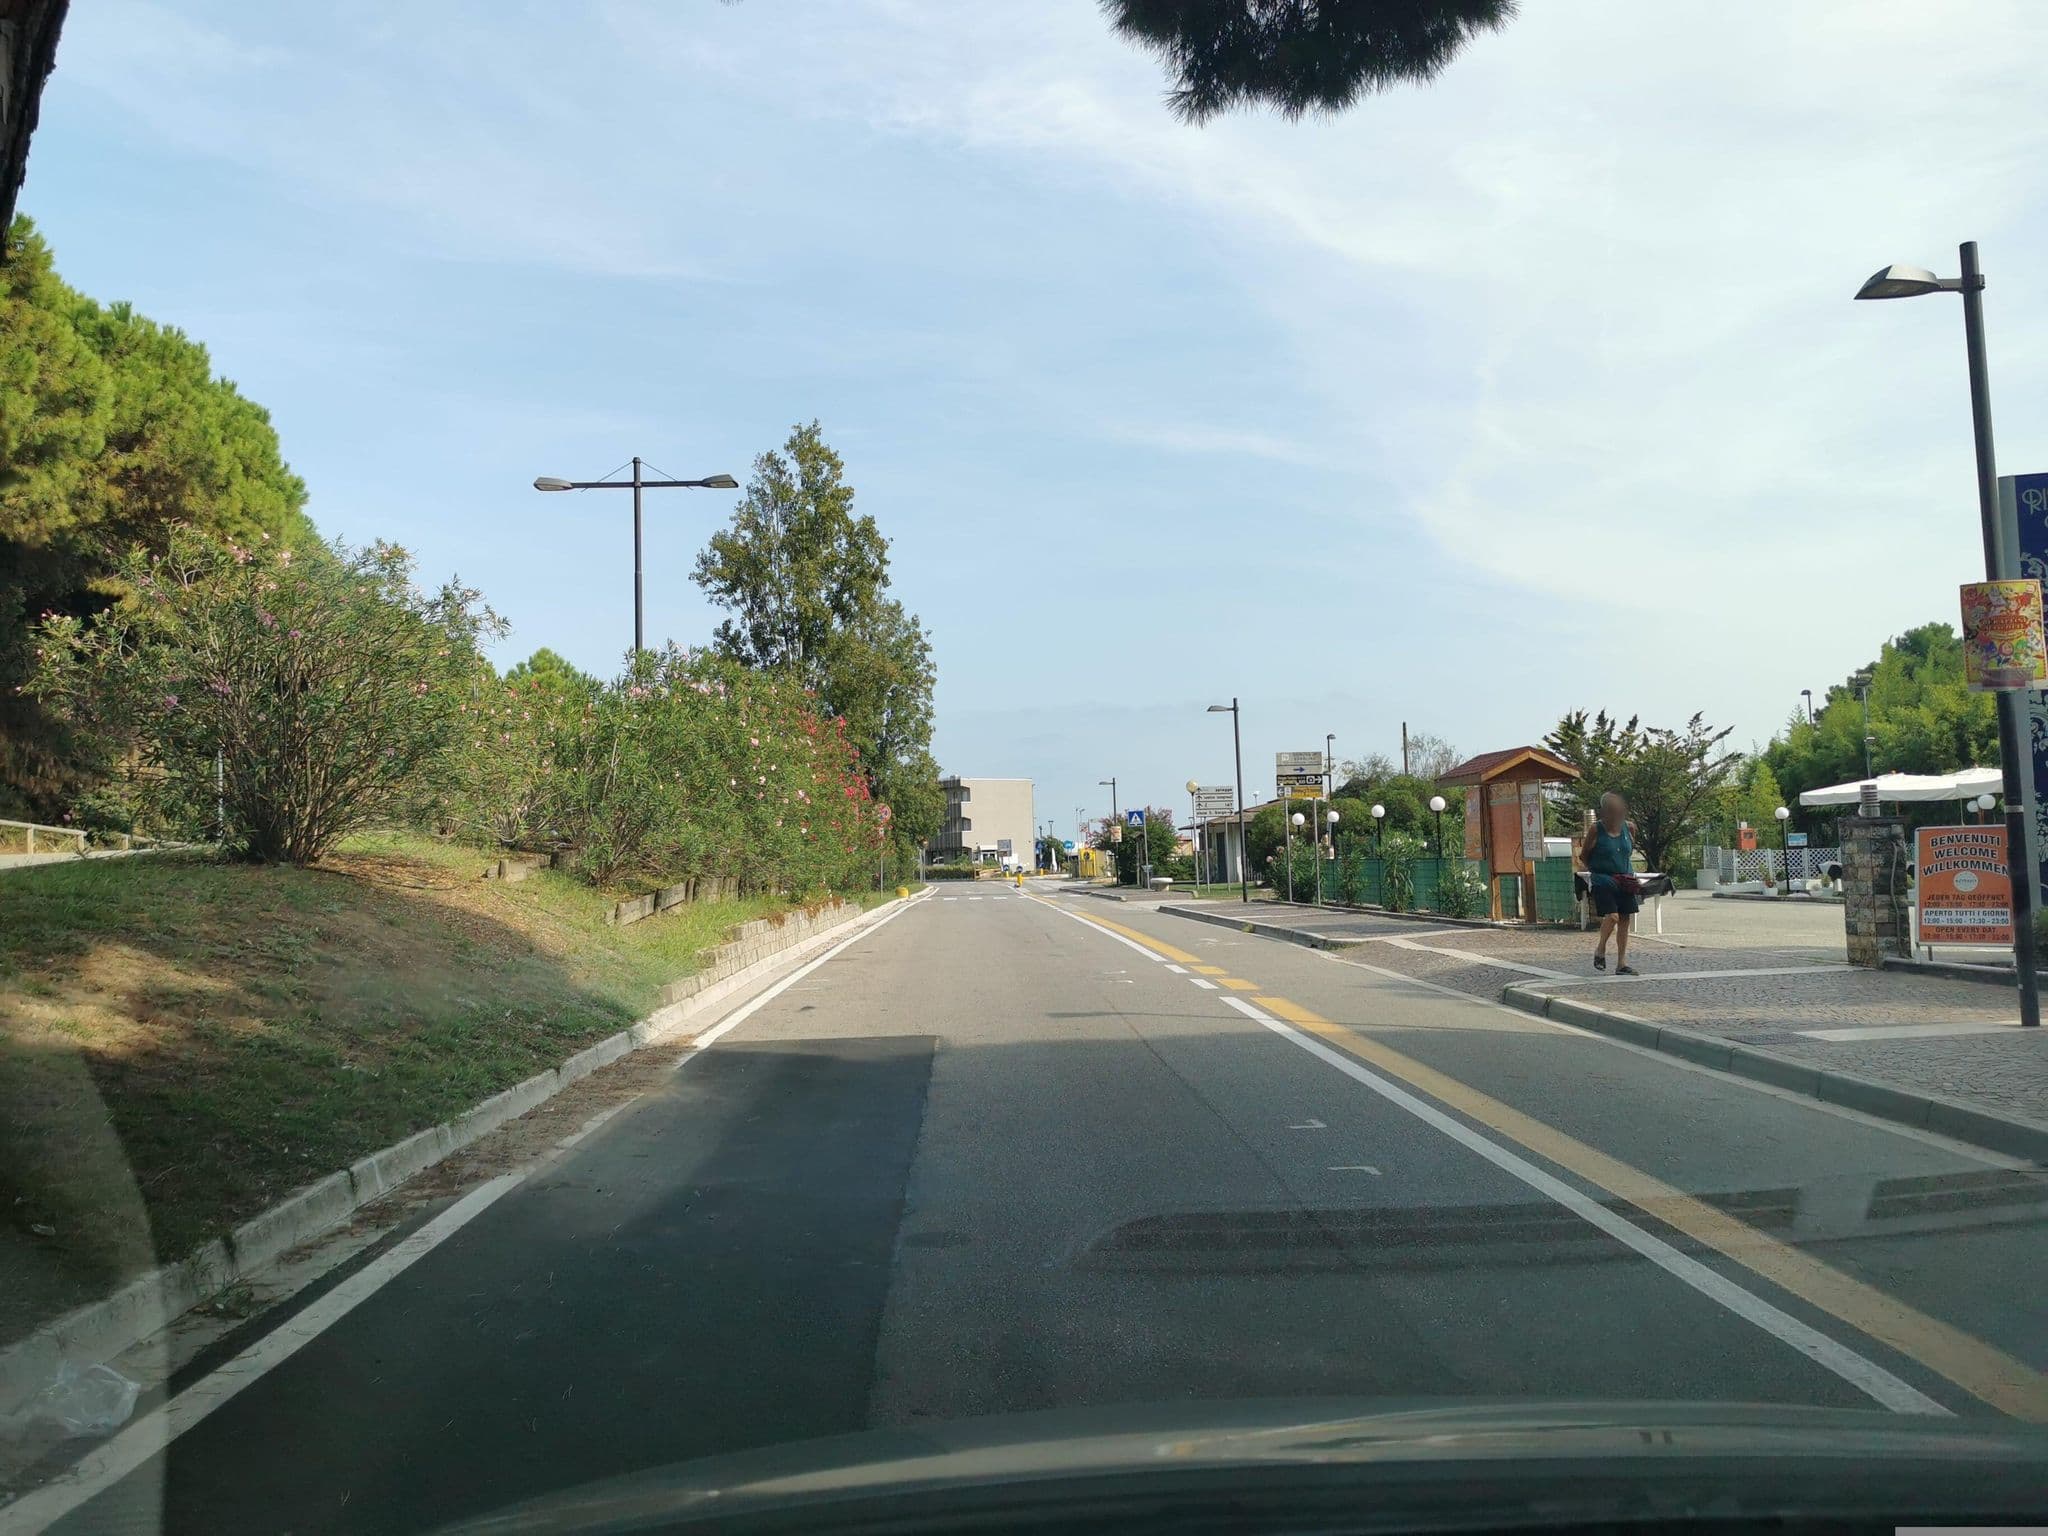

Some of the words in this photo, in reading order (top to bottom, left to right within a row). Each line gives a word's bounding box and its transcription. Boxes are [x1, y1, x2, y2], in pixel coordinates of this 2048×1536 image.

[1930, 833, 2001, 848] BENVENUTI
[1934, 846, 1998, 859] WELCOME
[1923, 860, 2009, 876] WILLKOMMEN
